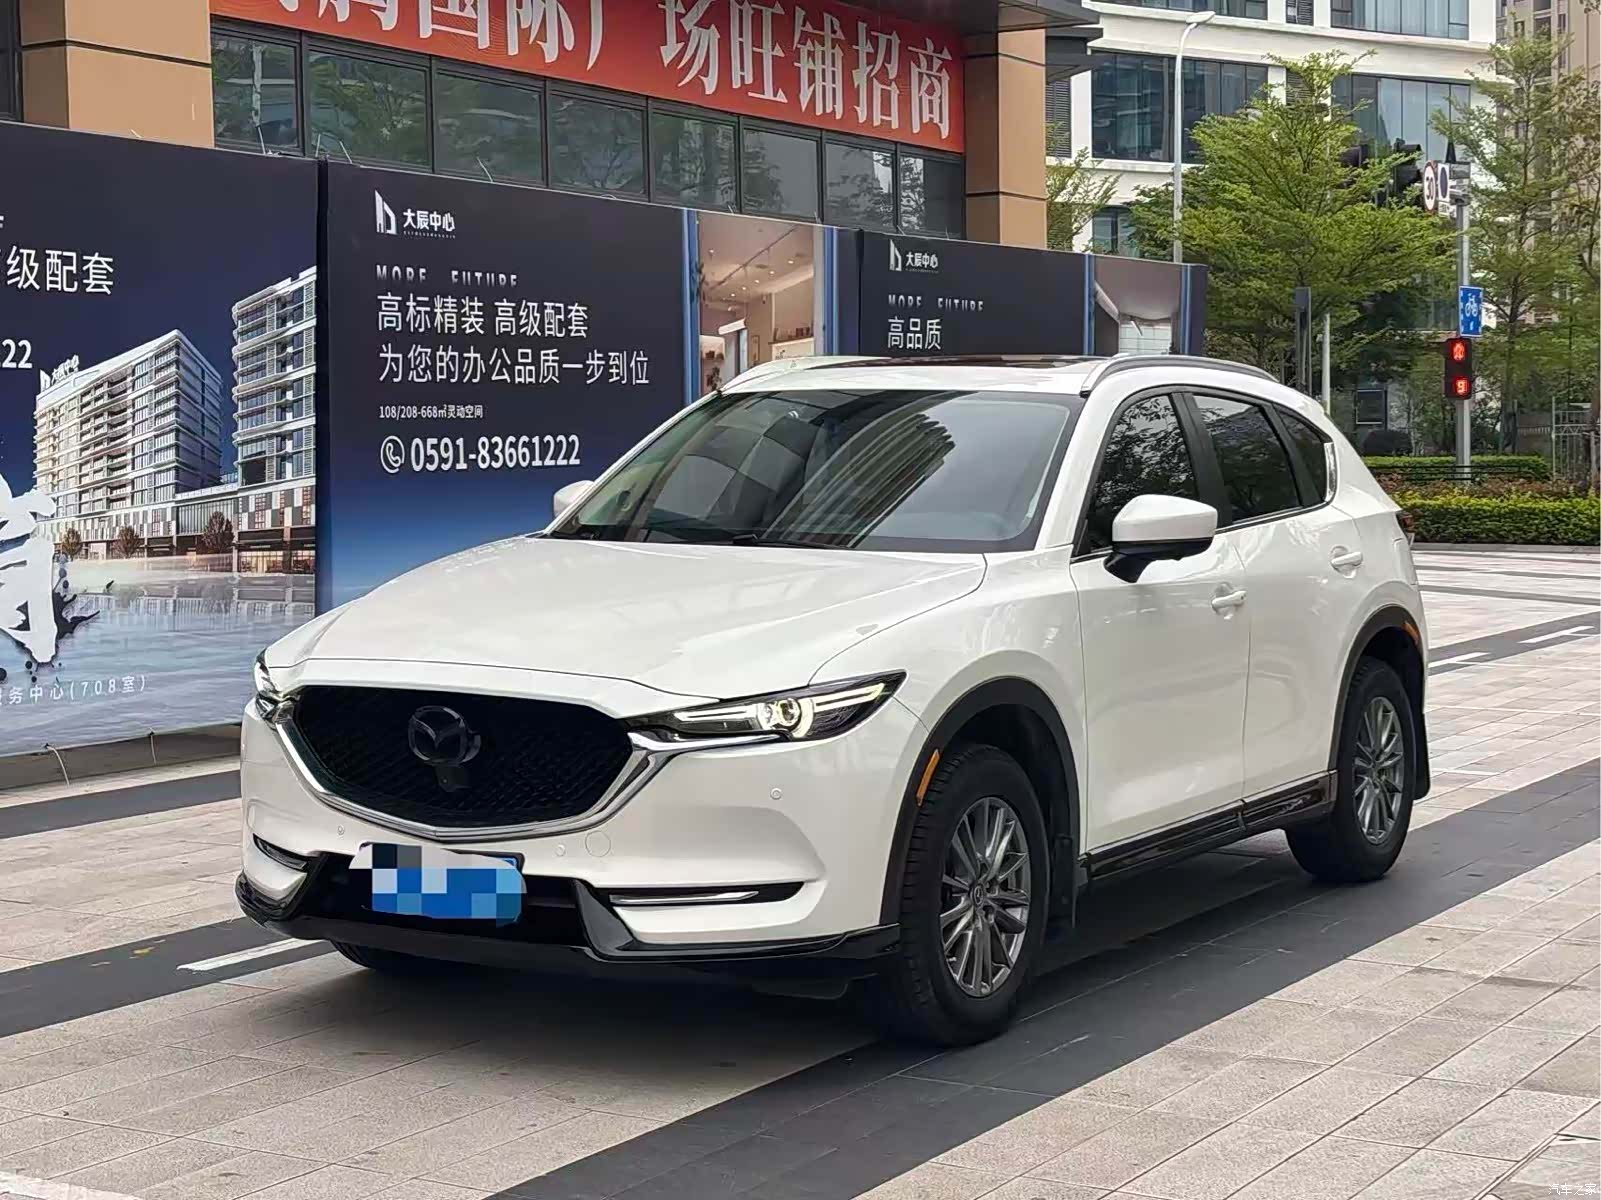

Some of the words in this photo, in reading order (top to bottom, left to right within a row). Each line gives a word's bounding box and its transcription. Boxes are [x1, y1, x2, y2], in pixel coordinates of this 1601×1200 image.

[402, 208, 456, 231] 大辰中心
[905, 252, 939, 268] 大辰中心
[377, 292, 485, 336] 高标精装
[494, 298, 589, 338] 高级配套
[888, 316, 942, 350] 高品质
[379, 343, 650, 386] 为您的办公品质一步到位
[410, 434, 581, 472] 0591-83661222
[0, 674, 146, 706] 务中心(708室)
